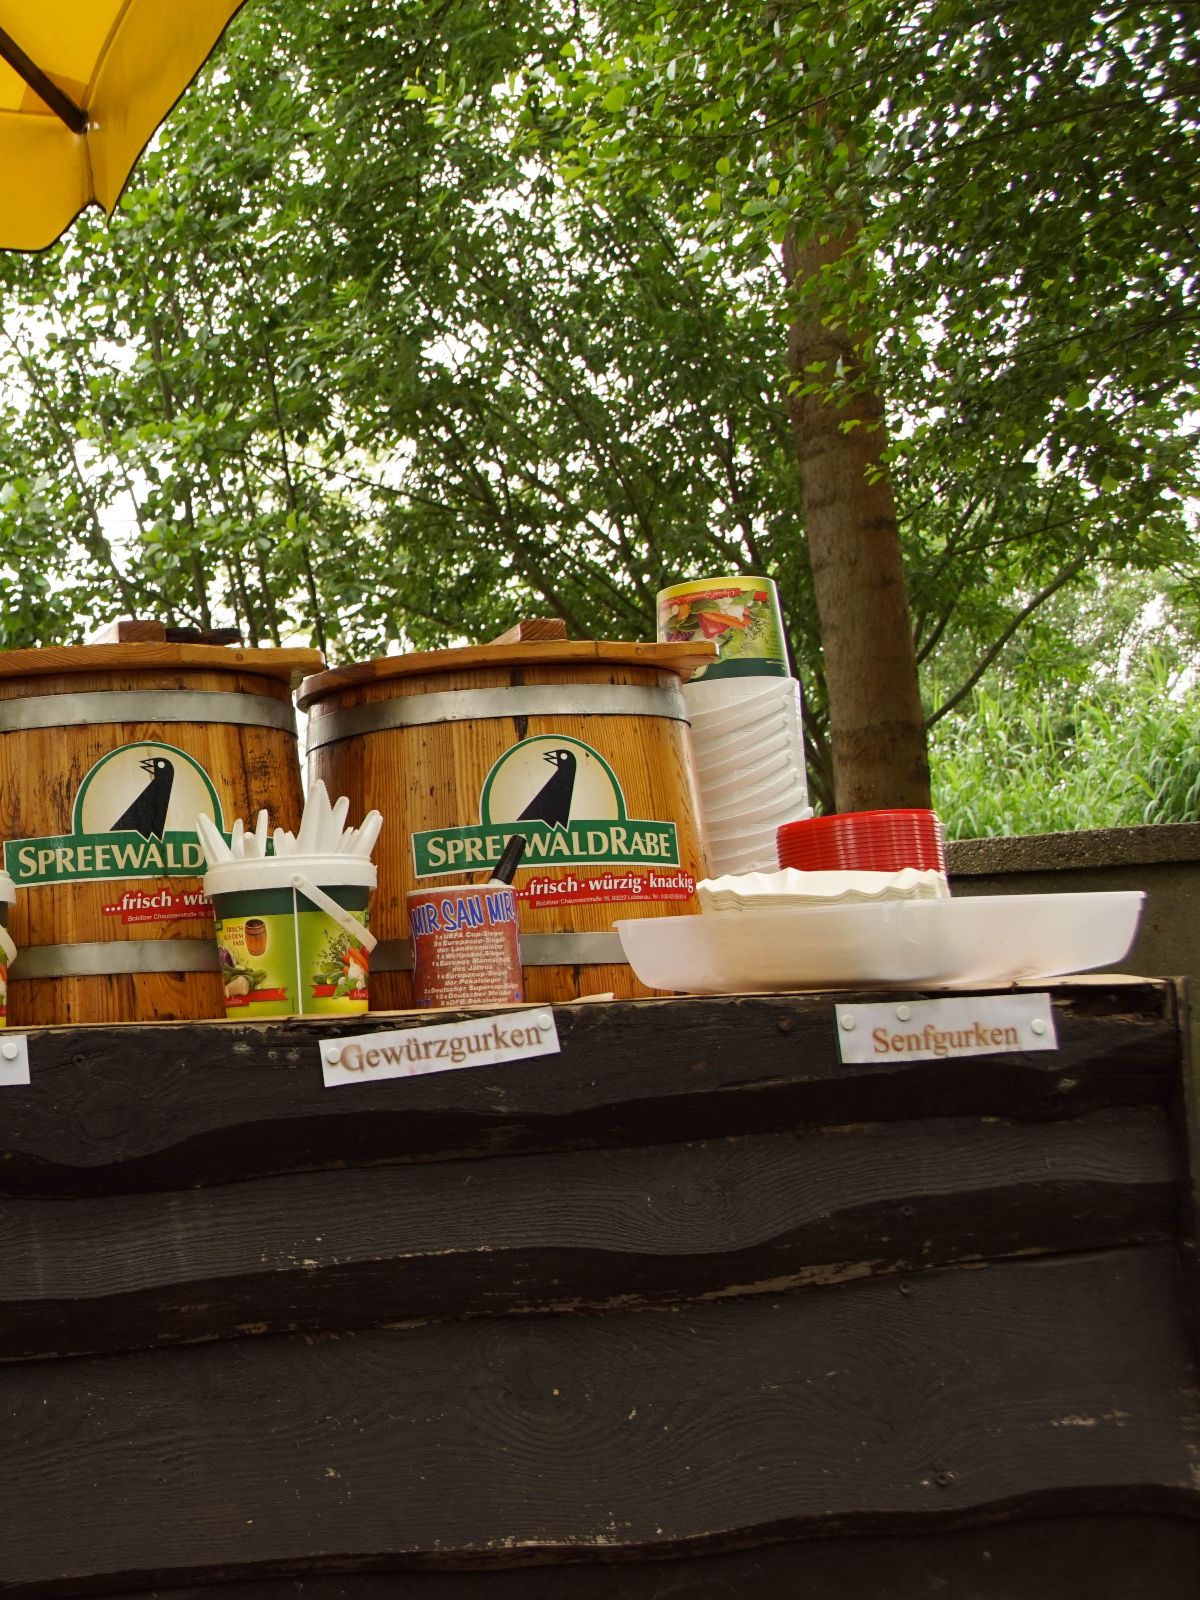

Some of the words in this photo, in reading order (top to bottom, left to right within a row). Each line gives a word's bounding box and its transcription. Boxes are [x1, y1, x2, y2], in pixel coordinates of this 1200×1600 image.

[18, 843, 204, 878] SPREEWALD
[588, 873, 642, 893] würzig
[649, 872, 694, 893] knackig
[412, 903, 440, 939] MIR
[441, 896, 485, 932] SAN
[340, 1023, 544, 1073] Gewürzgurken
[871, 1021, 1019, 1056] Senfgurken
